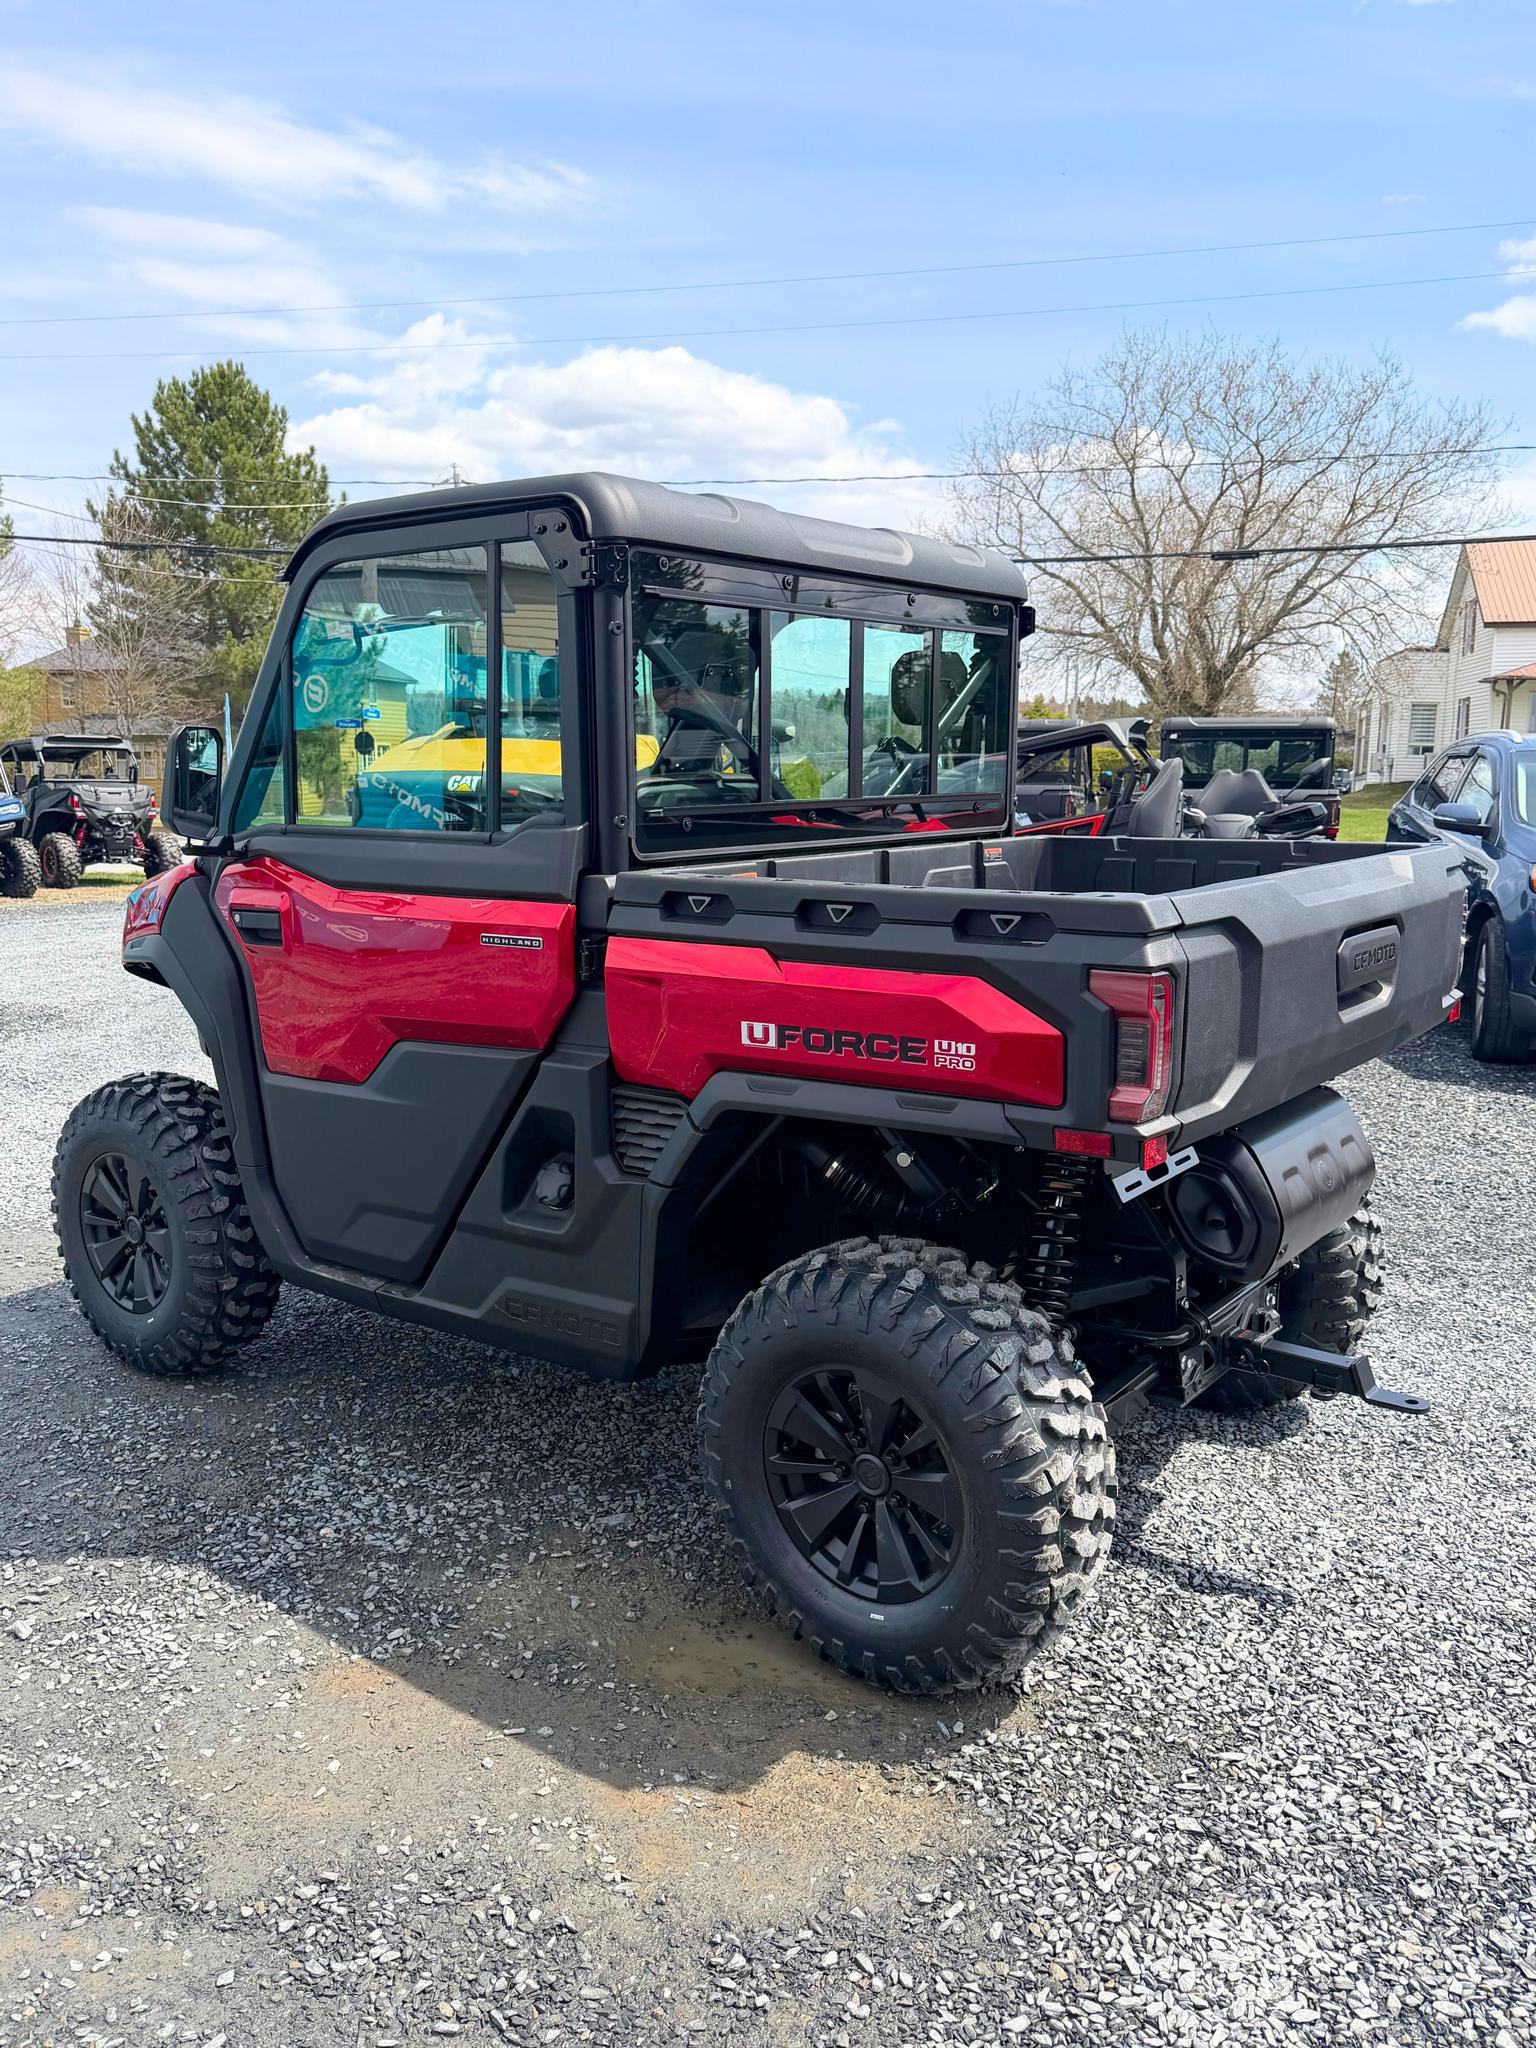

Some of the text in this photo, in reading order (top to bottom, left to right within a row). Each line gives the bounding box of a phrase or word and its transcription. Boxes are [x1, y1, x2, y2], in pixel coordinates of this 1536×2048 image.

[447, 775, 482, 792] CAT
[482, 937, 541, 946] HIGHLAND
[1353, 943, 1396, 972] CFMOTO
[934, 1039, 976, 1056] U10
[934, 1056, 976, 1071] PRO
[504, 1297, 621, 1346] CFMOTO
